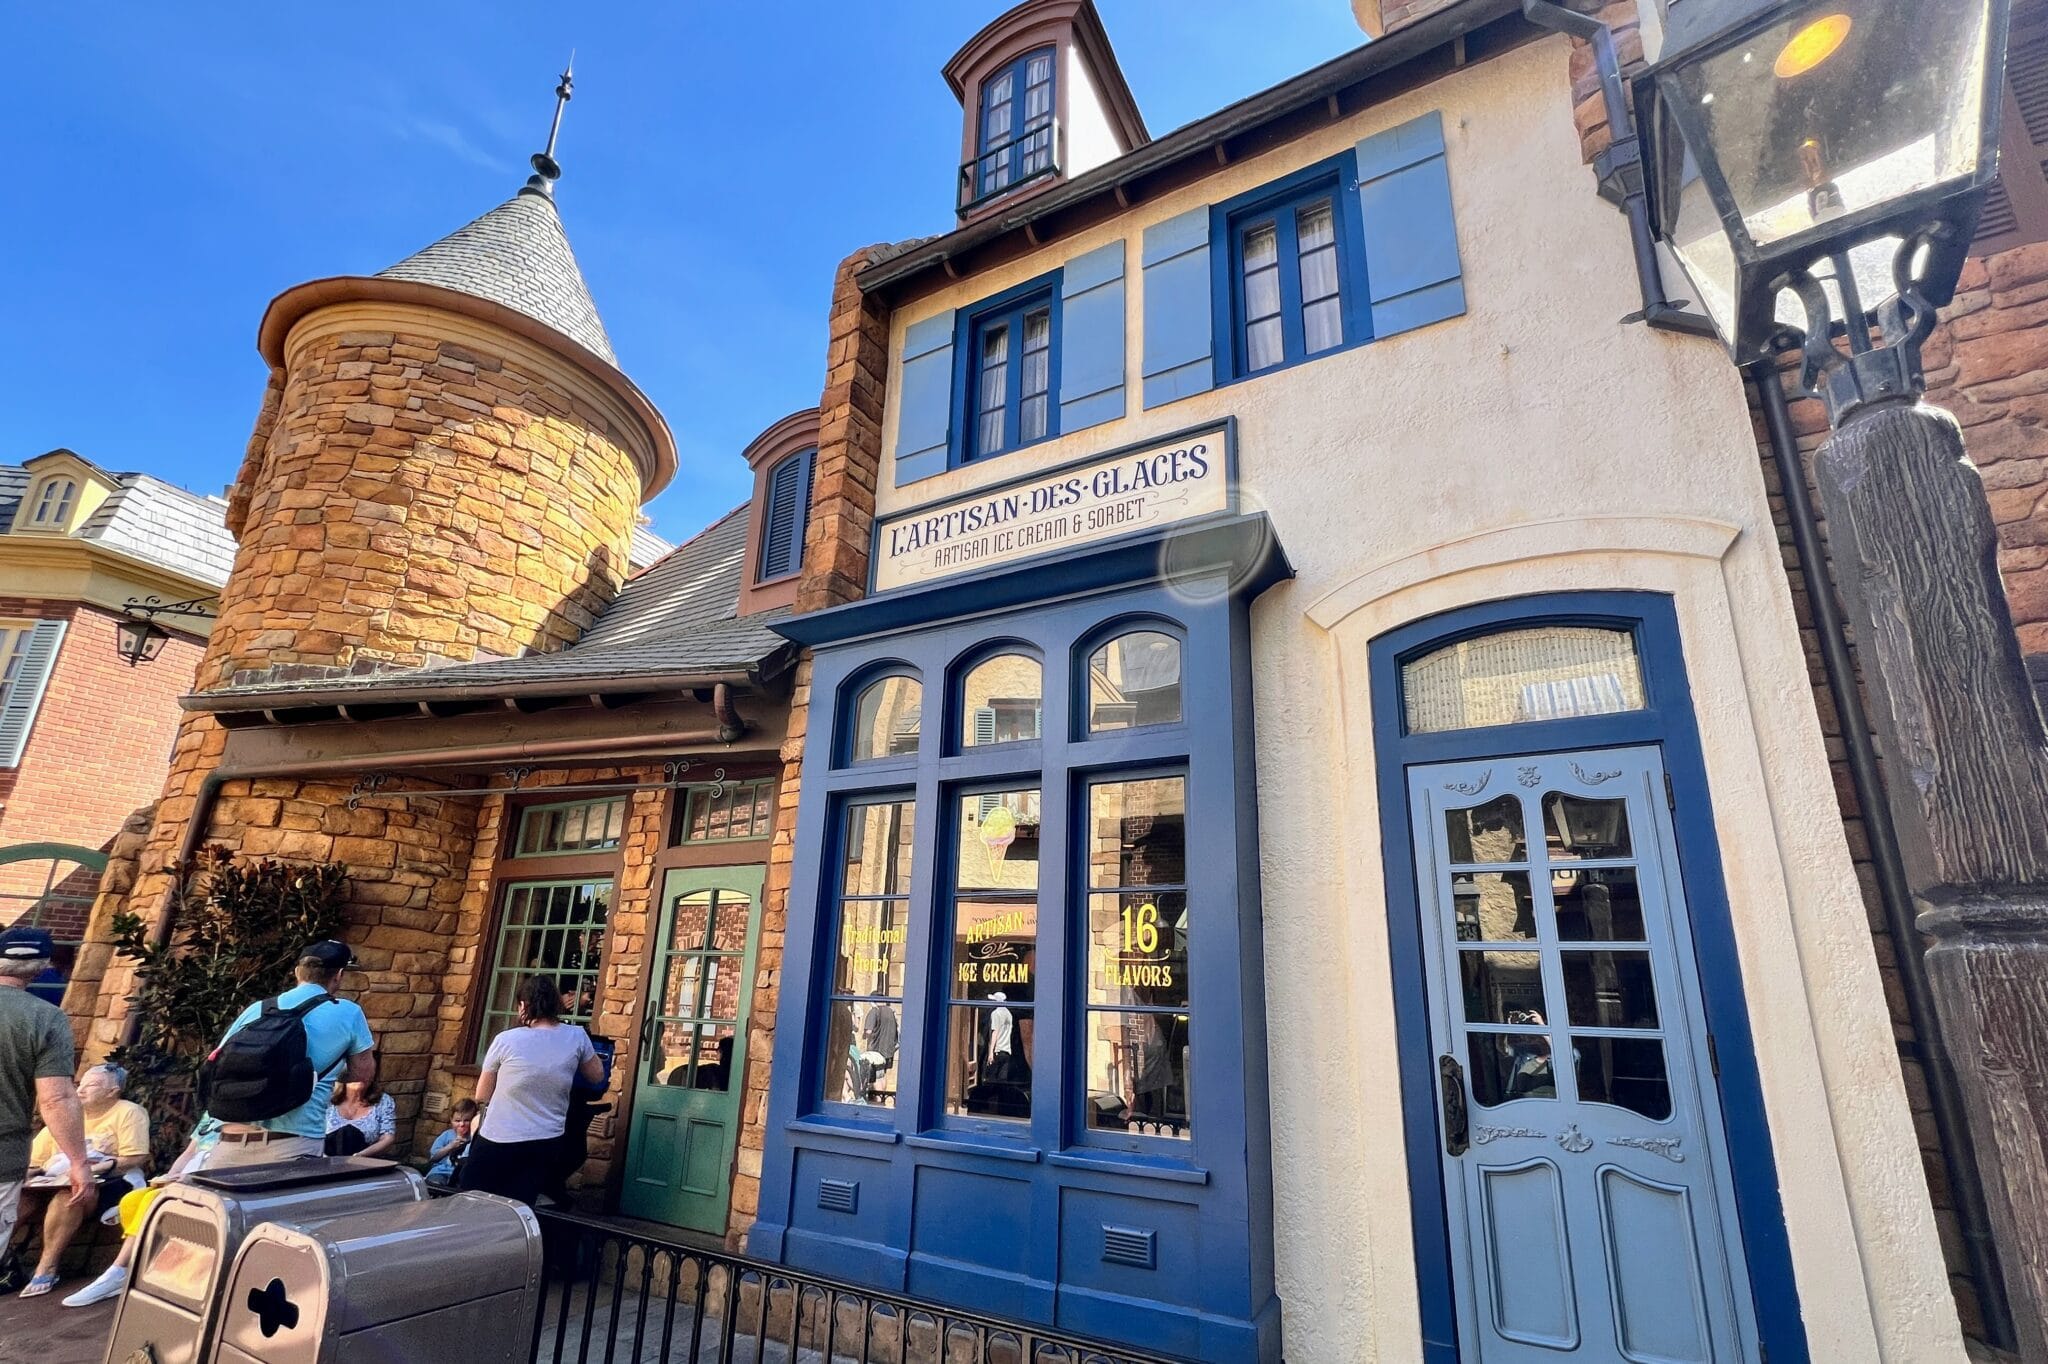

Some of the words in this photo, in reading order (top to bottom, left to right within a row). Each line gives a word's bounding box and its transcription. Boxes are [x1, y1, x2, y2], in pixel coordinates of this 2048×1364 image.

[1092, 444, 1209, 499] GLACES
[934, 537, 988, 568] ARTISAN
[994, 531, 1014, 553] ICE
[1018, 517, 1067, 547] CREAM
[1072, 514, 1083, 533] &
[1088, 498, 1145, 530] SORBET
[844, 924, 906, 944] Traditional
[966, 911, 1023, 944] ARTISAN
[1121, 903, 1158, 953] 16
[853, 952, 889, 974] French
[958, 962, 978, 982] ICE
[982, 962, 1029, 983] CREAM
[1105, 964, 1172, 987] FLAVORS
